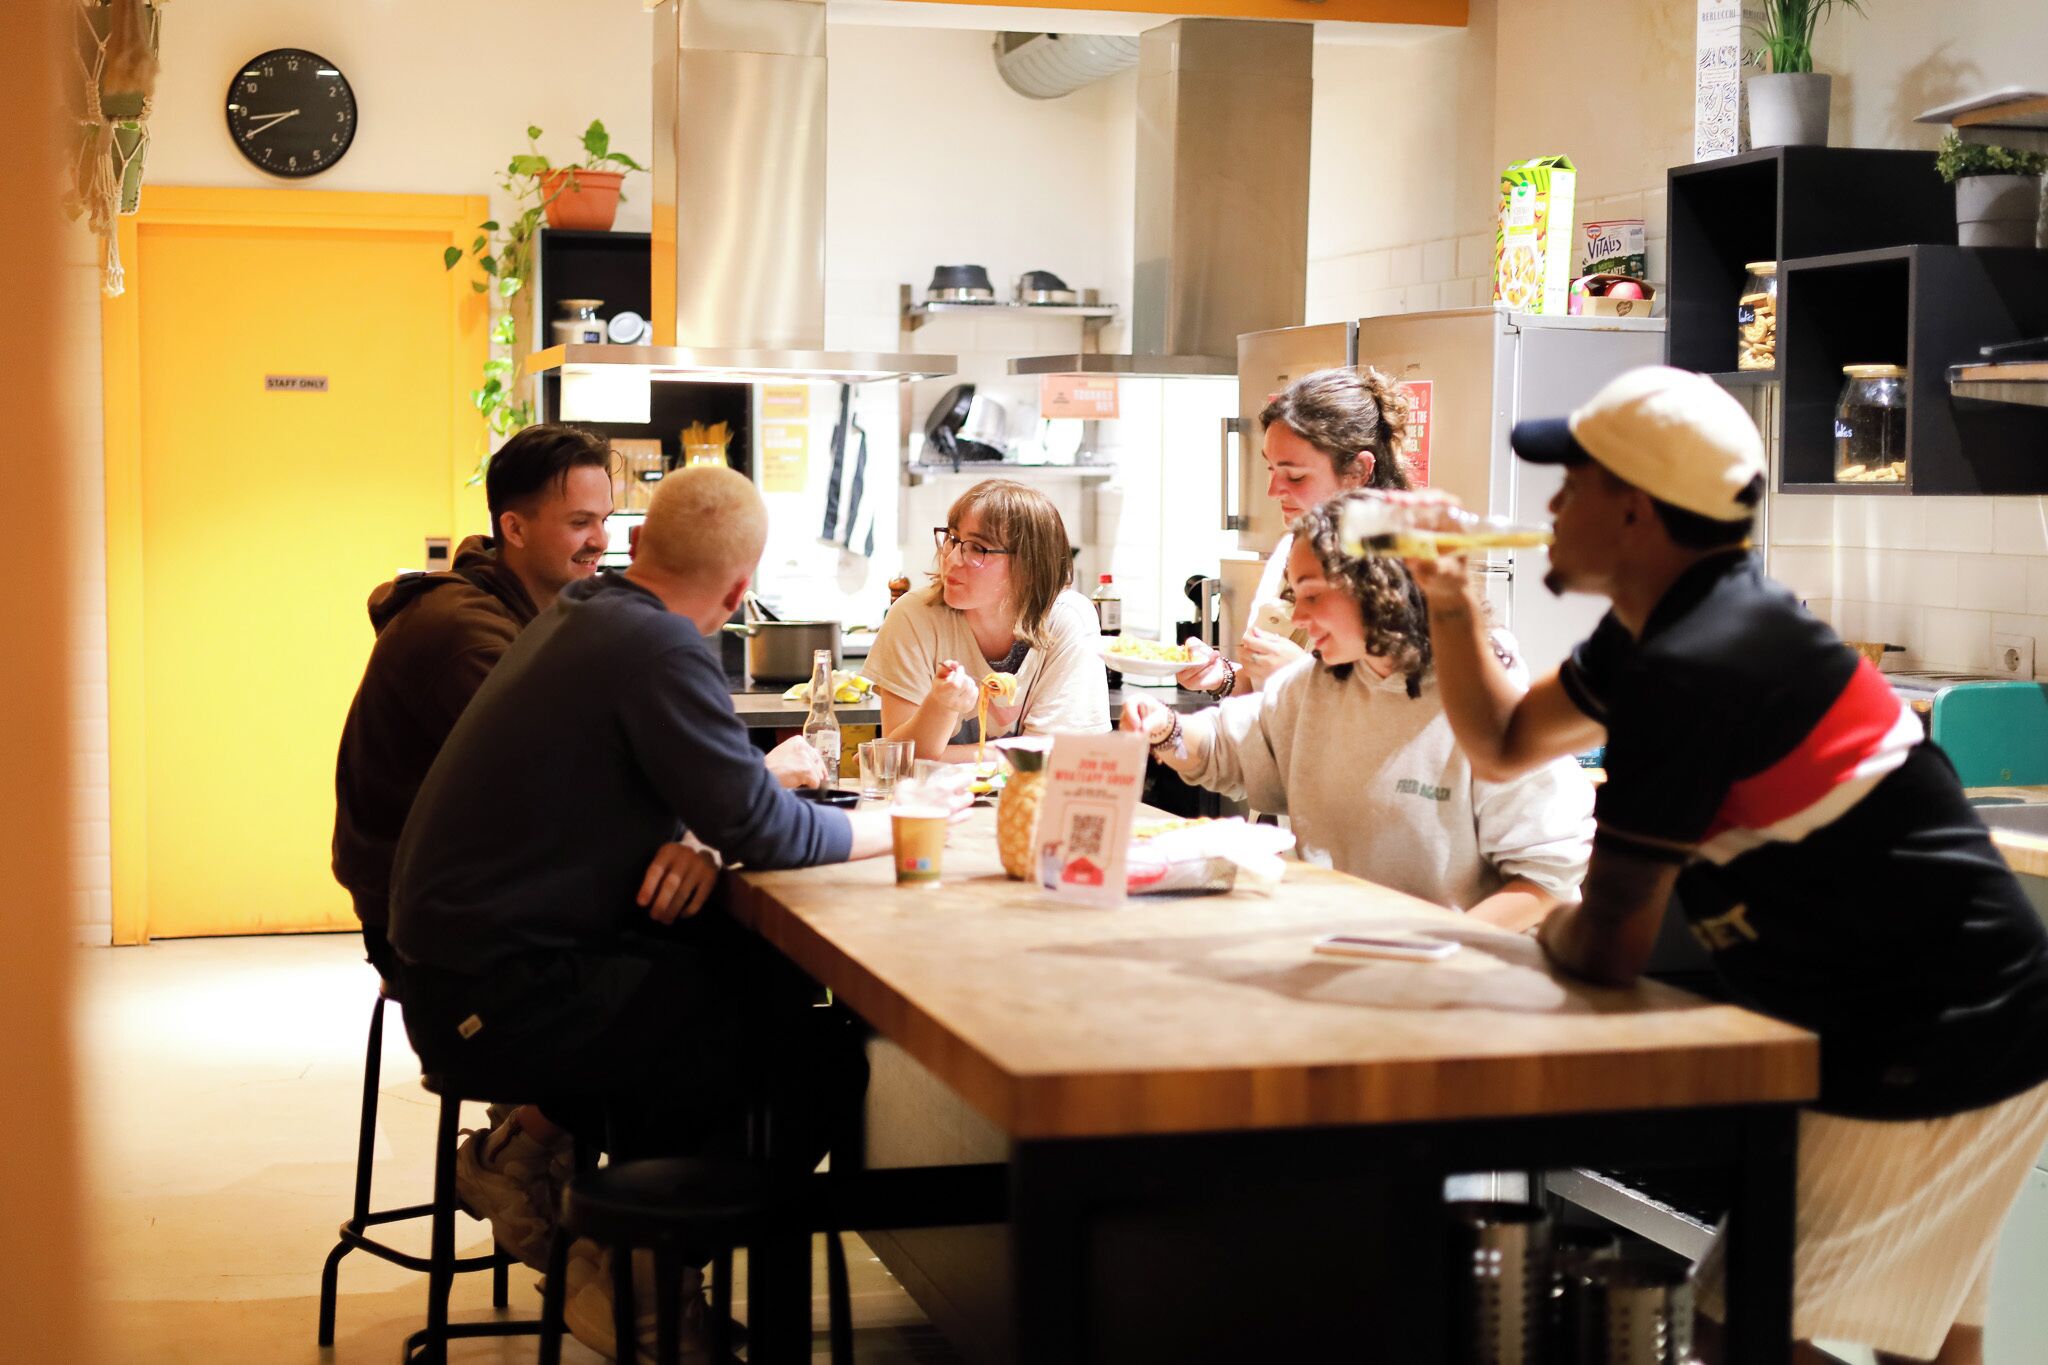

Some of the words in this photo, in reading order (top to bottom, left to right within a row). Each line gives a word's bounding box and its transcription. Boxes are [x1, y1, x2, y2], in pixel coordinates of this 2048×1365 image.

[287, 60, 298, 71] 12
[264, 67, 273, 77] 11
[247, 83, 257, 93] 10
[329, 86, 336, 97] 2
[240, 106, 247, 117] 9
[336, 112, 344, 122] 3
[331, 133, 338, 143] 4
[265, 148, 272, 159] 7
[313, 149, 320, 161] 5
[289, 156, 297, 167] 6
[268, 378, 297, 387] STAFF
[300, 379, 324, 388] ONLY
